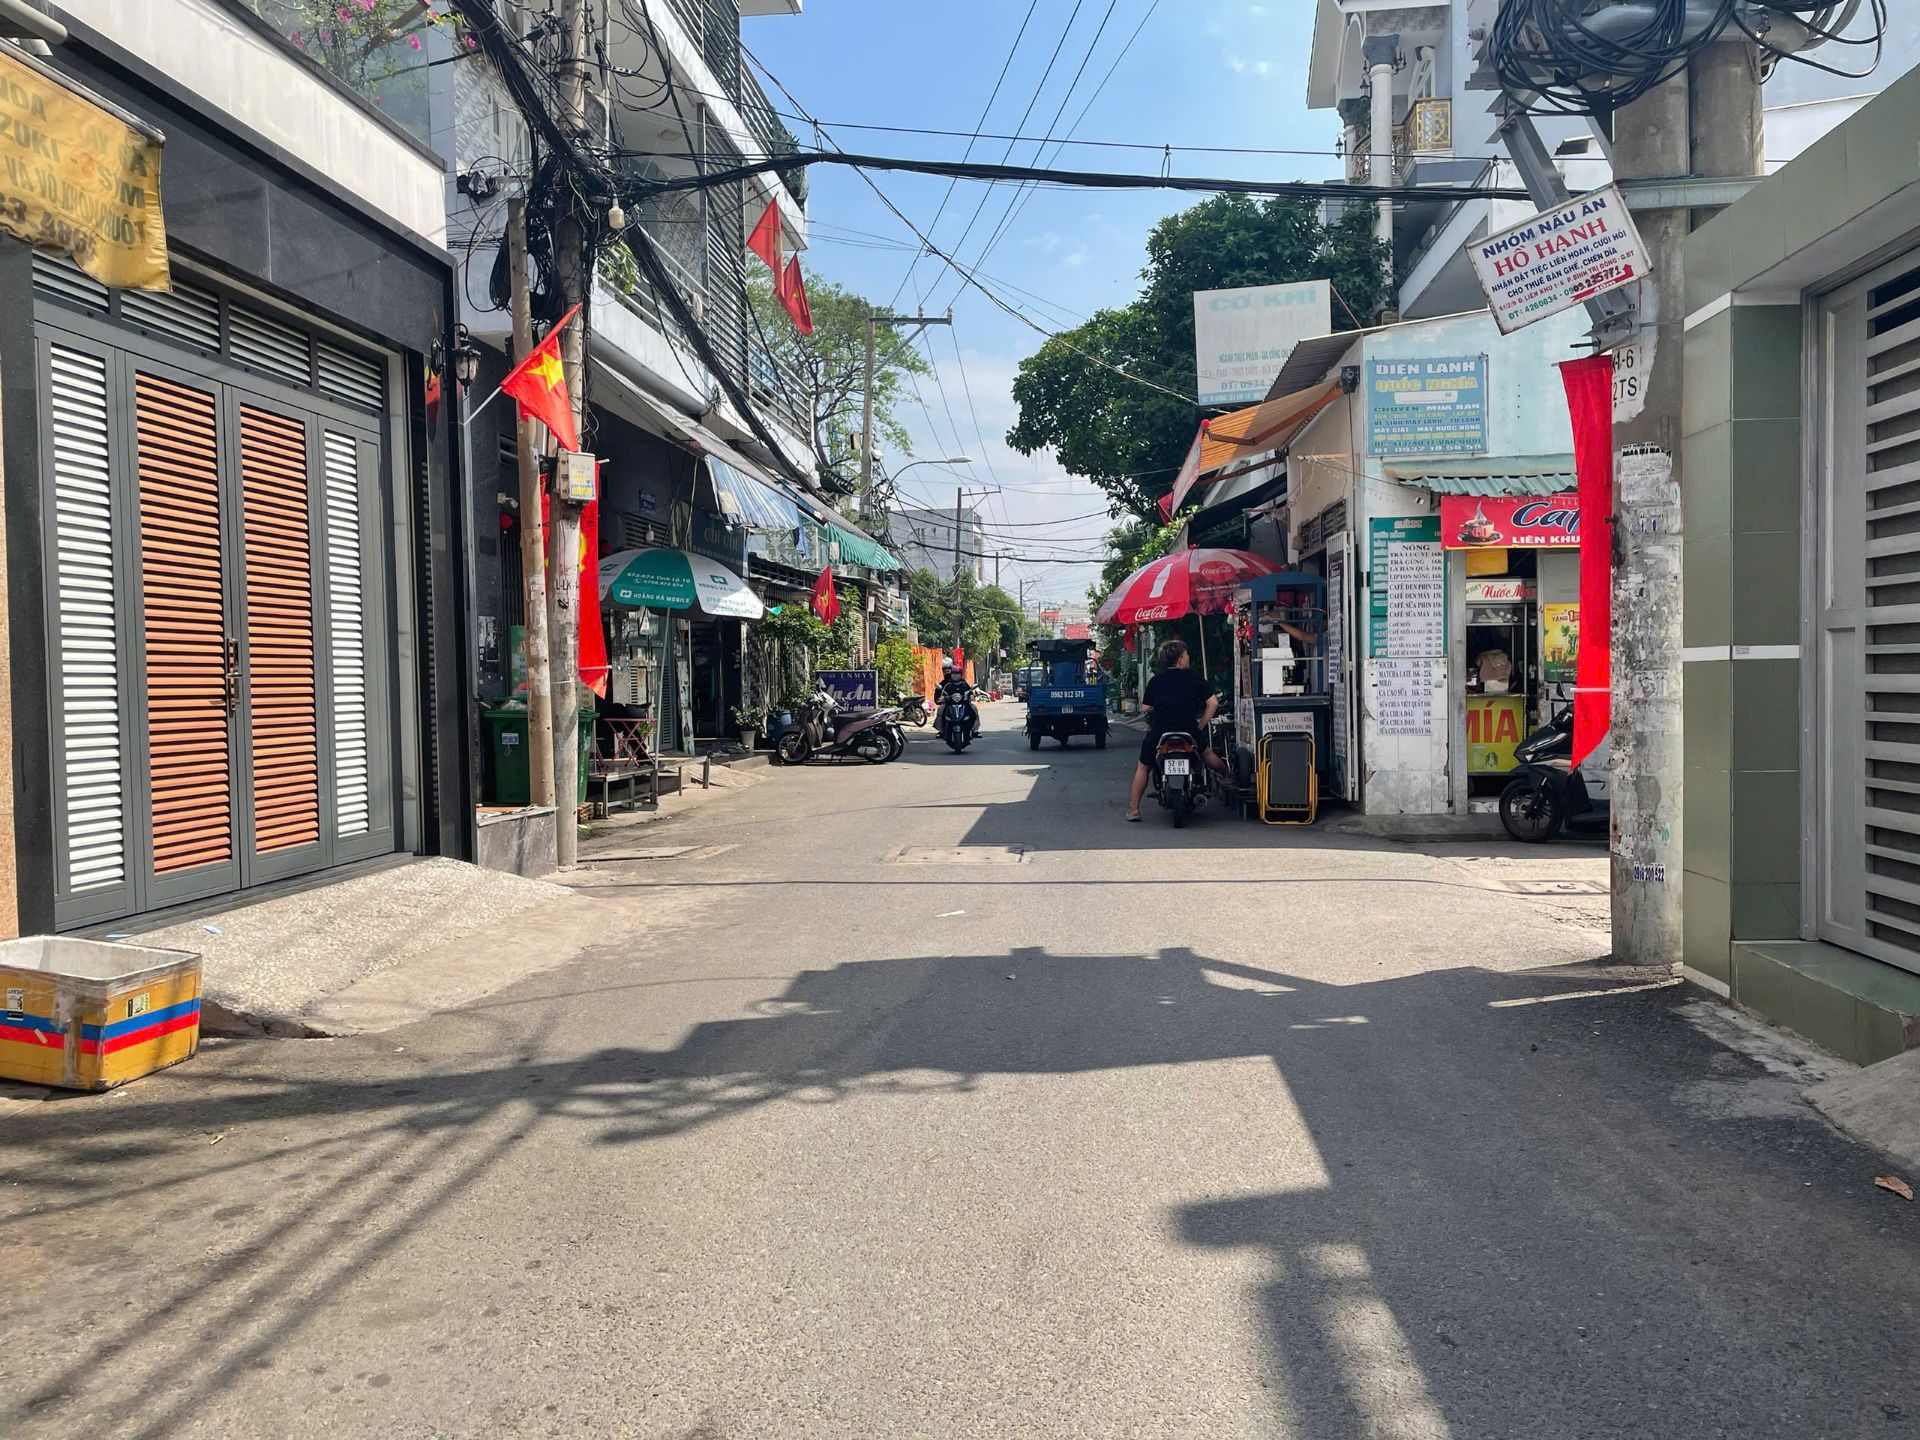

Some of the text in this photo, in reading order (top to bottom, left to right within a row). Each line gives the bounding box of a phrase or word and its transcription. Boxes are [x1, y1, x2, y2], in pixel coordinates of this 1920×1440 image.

[1482, 197, 1607, 259] NHÓM NẤU ĂN
[1493, 217, 1608, 277] HỒ HẠNH
[1491, 279, 1514, 293] NHẬN
[1530, 263, 1549, 275] TIỆC
[1549, 255, 1567, 268] LIÊN
[1568, 246, 1594, 260] HOAN,
[1508, 286, 1524, 298] CHO
[1524, 277, 1546, 291] THUÊ
[1546, 269, 1562, 282] BÀN
[1583, 252, 1604, 266] CHÉN
[1540, 285, 1553, 294] KHU
[1525, 294, 1558, 313] 4260834
[1375, 361, 1475, 377] ĐIỆN LẠNH
[1512, 535, 1580, 544] LIÊN KHU
[633, 592, 655, 600] HOÀNG
[666, 595, 690, 603] MOBILE
[1482, 583, 1511, 598] Nước
